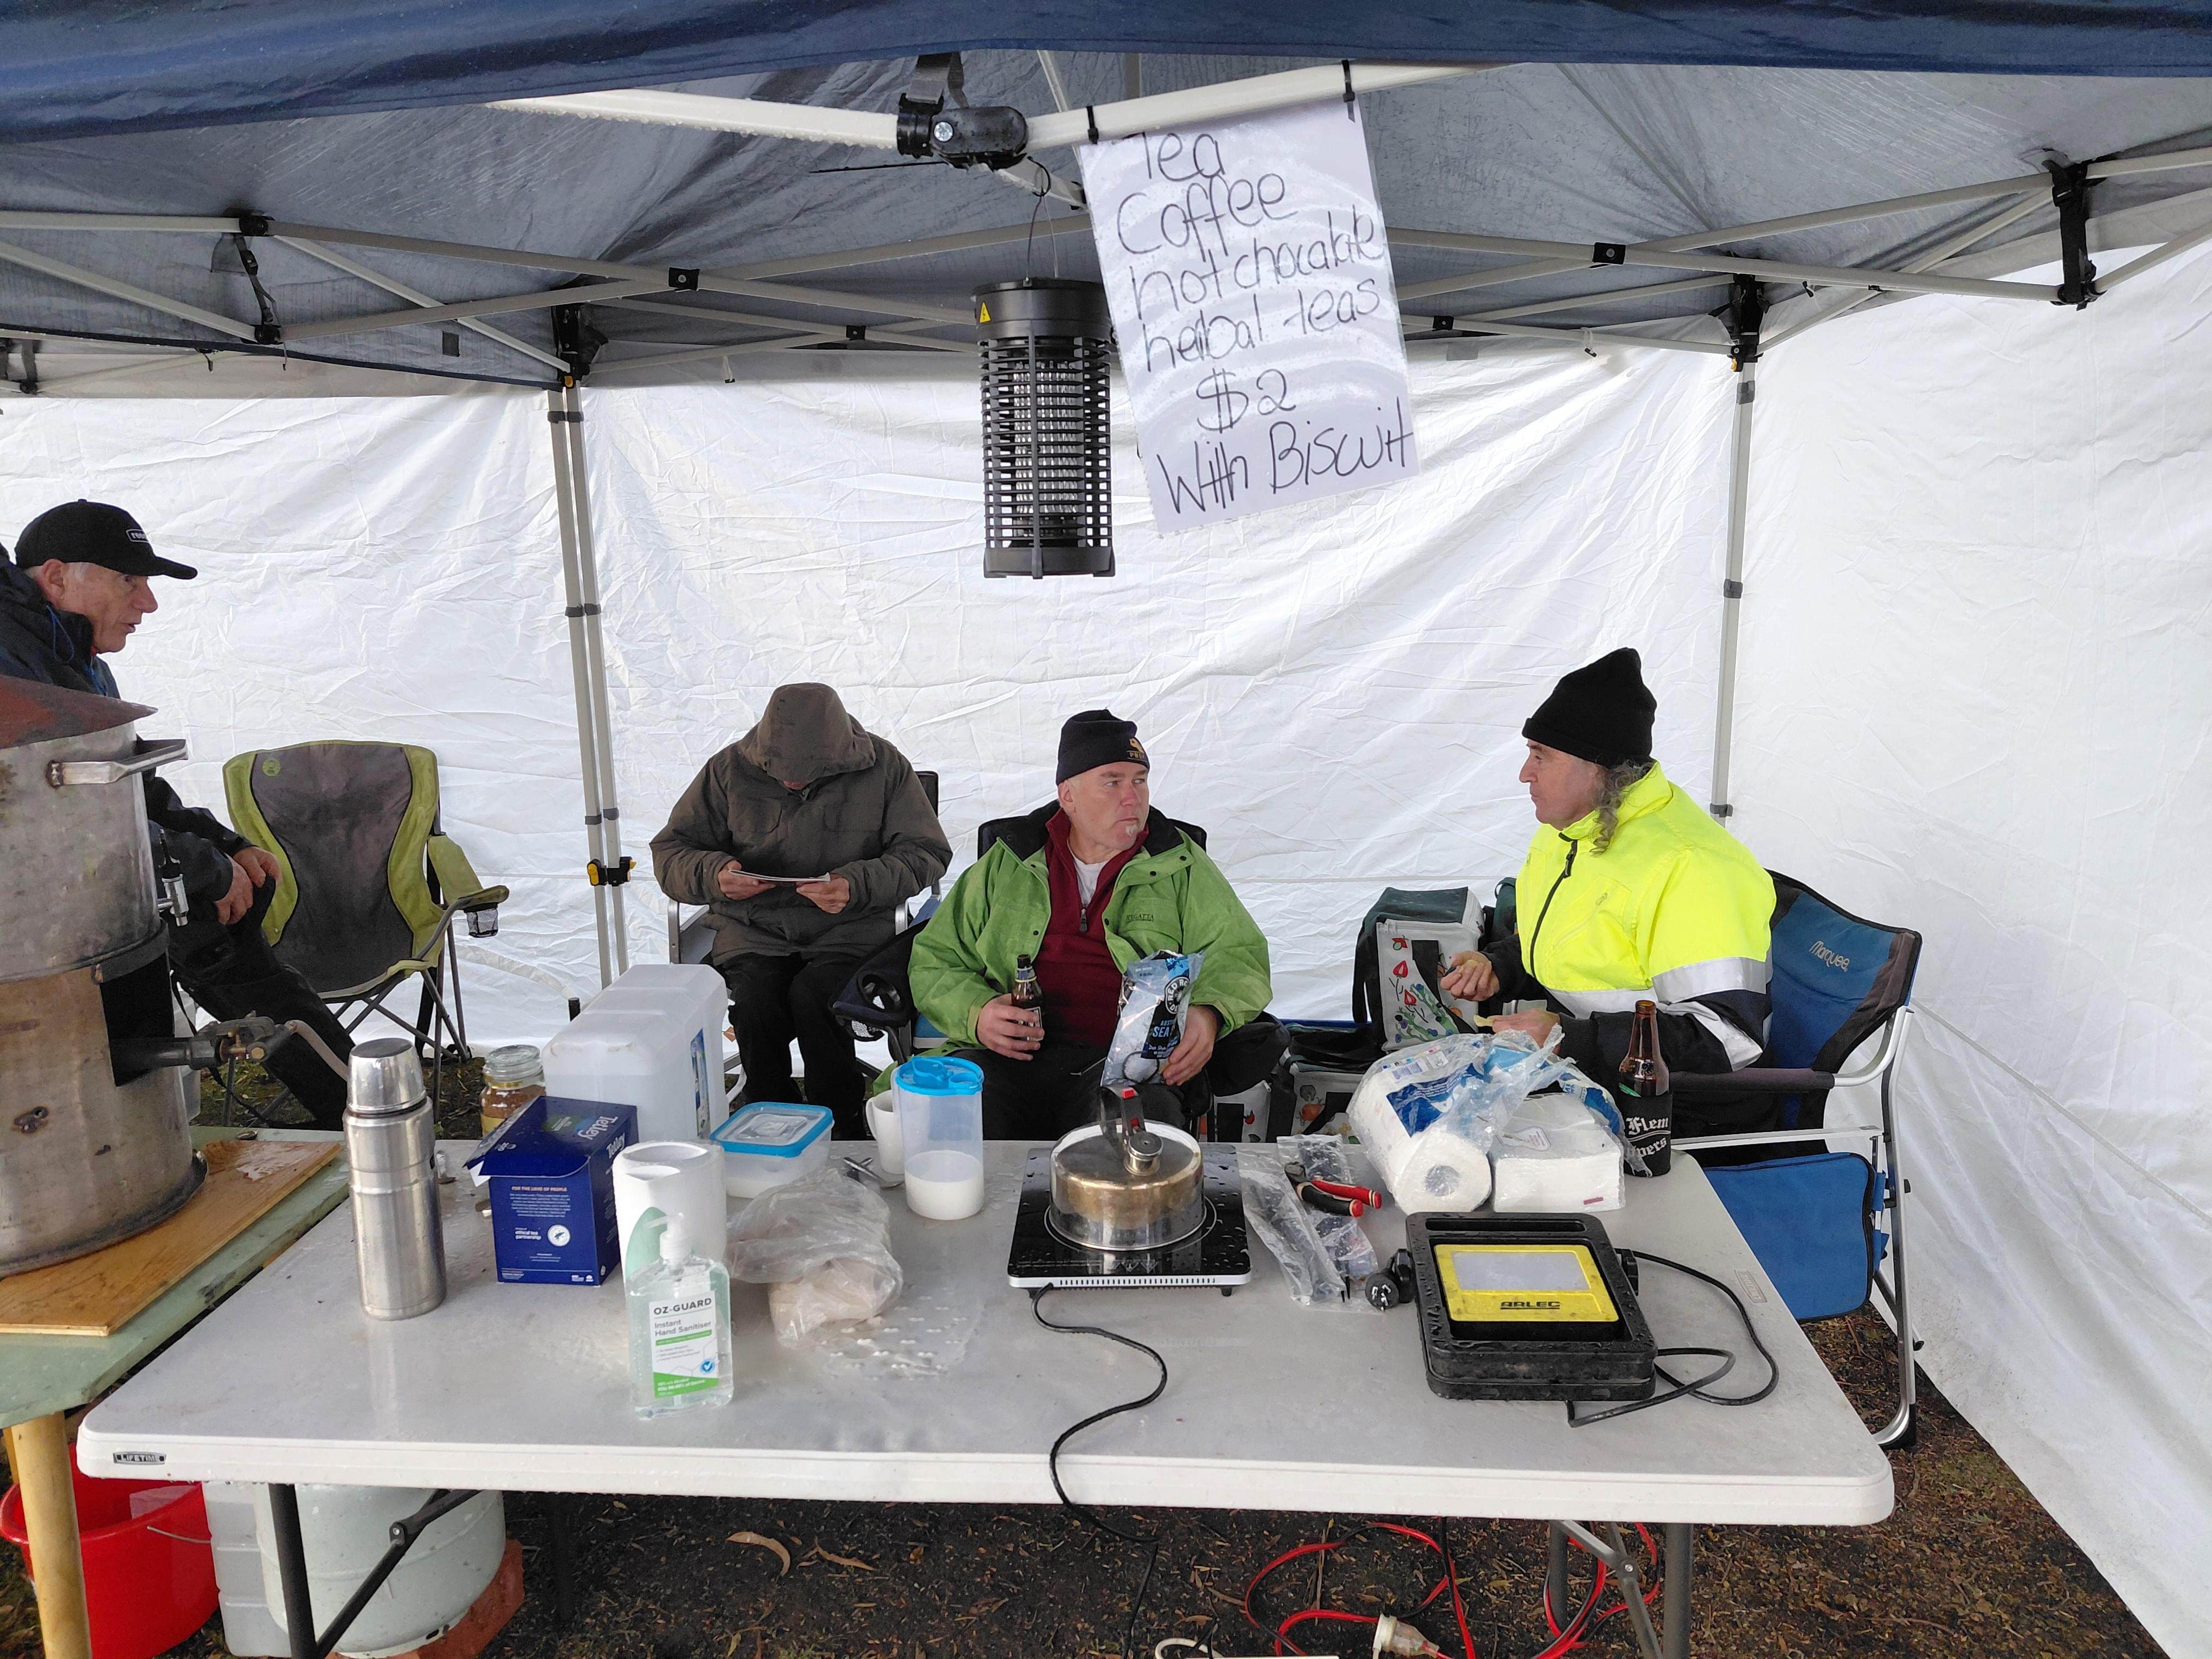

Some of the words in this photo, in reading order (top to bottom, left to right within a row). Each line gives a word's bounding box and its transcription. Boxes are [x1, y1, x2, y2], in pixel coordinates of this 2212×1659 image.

[1122, 131, 1225, 182] Tea
[1117, 173, 1298, 262] Coffee
[1283, 278, 1380, 335] teas
[1156, 441, 1249, 514] With
[1270, 396, 1414, 494] Biscuit
[1809, 940, 1850, 972] Marquee
[1167, 982, 1178, 1001] RED
[1153, 1026, 1169, 1037] SEA
[577, 1116, 619, 1140] Tetley
[1626, 1117, 1669, 1135] Flem
[653, 1297, 712, 1315] OZ-GUARD
[654, 1319, 681, 1328] Instant
[654, 1327, 676, 1336] Hand
[678, 1321, 712, 1333] Sanitiser
[120, 1454, 159, 1462] LIFETIM
